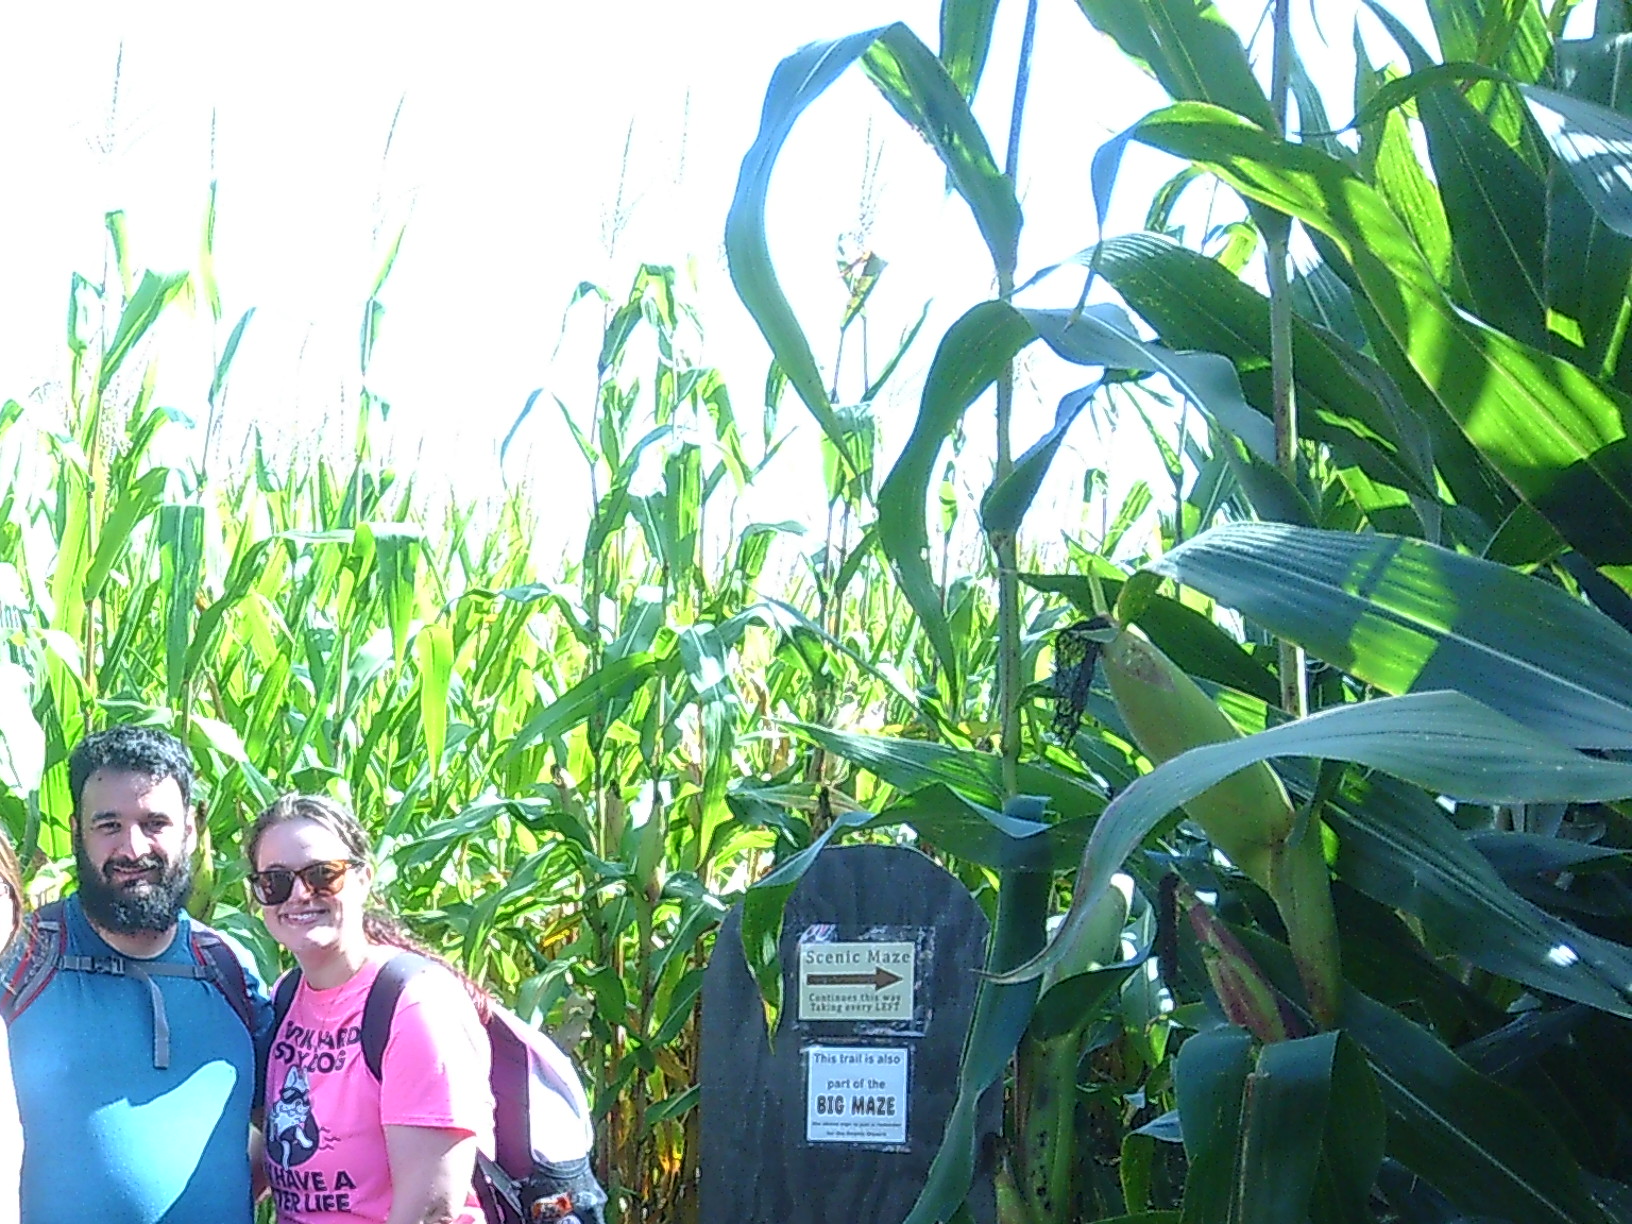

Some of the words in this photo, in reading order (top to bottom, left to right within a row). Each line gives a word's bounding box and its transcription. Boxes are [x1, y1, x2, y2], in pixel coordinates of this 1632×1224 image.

[806, 950, 860, 964] Scenic
[868, 950, 911, 963] Maze
[809, 993, 857, 1002] Continues
[860, 993, 880, 1001] this
[810, 1003, 842, 1013] Taking
[845, 1004, 872, 1013] every
[876, 1002, 900, 1012] LEFT
[814, 1053, 837, 1063] This
[839, 1053, 862, 1063] trail
[865, 1054, 875, 1064] is
[877, 1054, 901, 1064] also
[827, 1079, 850, 1090] part
[853, 1079, 865, 1089] of
[868, 1079, 886, 1089] the
[817, 1095, 845, 1115] BIG
[851, 1095, 896, 1116] MAZE
[274, 1166, 327, 1191] HAVE
[334, 1170, 356, 1190] A
[305, 1193, 351, 1212] LIFE
